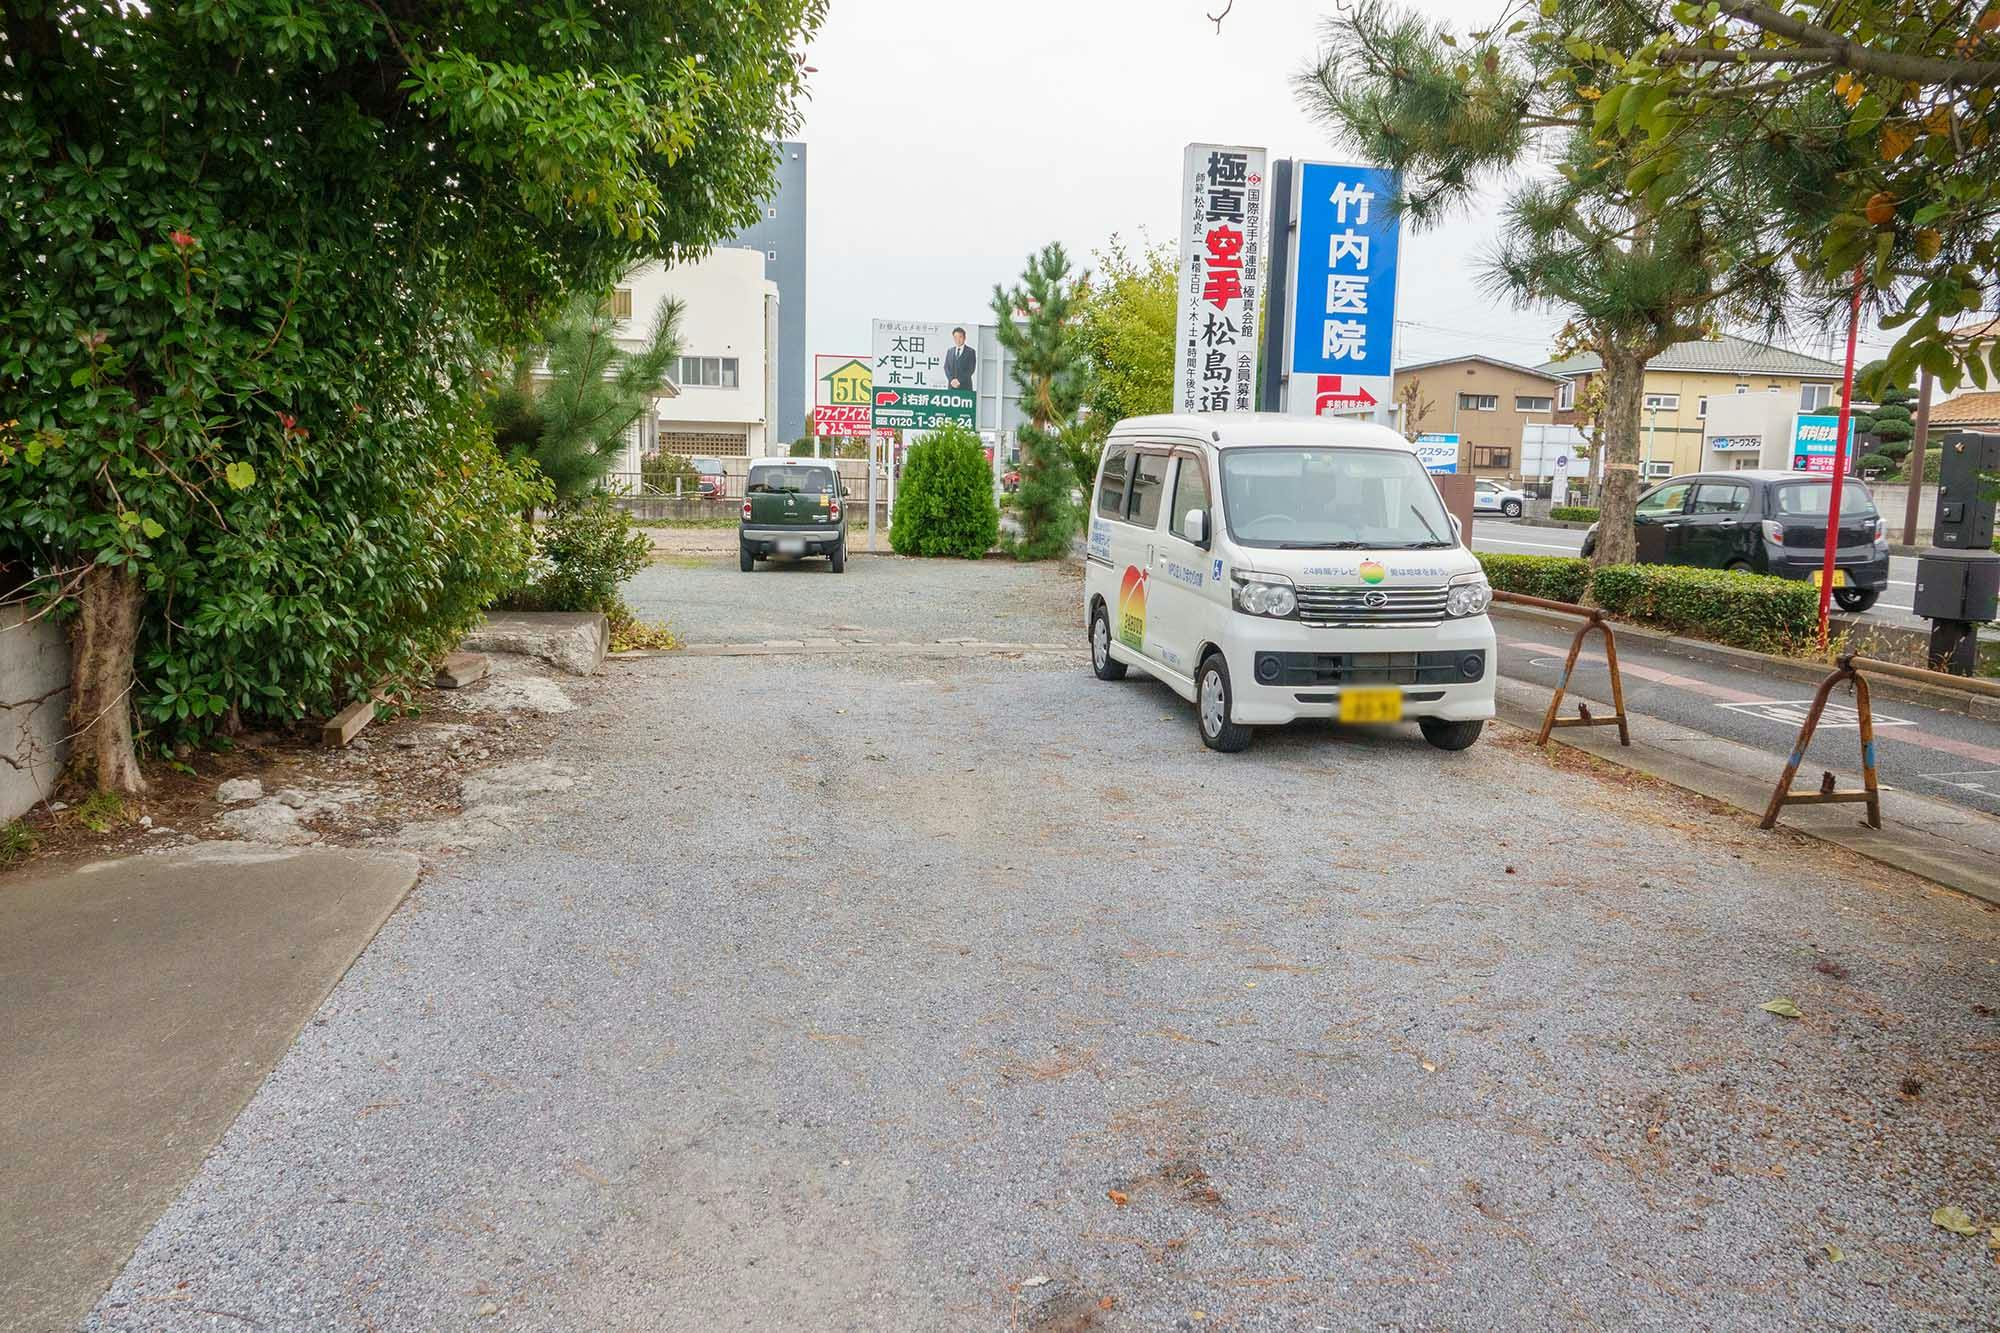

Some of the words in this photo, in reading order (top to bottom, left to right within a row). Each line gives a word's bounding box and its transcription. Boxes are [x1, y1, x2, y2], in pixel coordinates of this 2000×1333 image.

[1321, 181, 1375, 361] 竹内医院
[1241, 285, 1255, 337] 極真会館
[891, 335, 925, 353] 太田
[877, 354, 940, 370] メモリード
[888, 370, 927, 385] ホール
[1236, 353, 1251, 410] 会員募集
[907, 393, 929, 406] 右折
[930, 394, 973, 408] 400m
